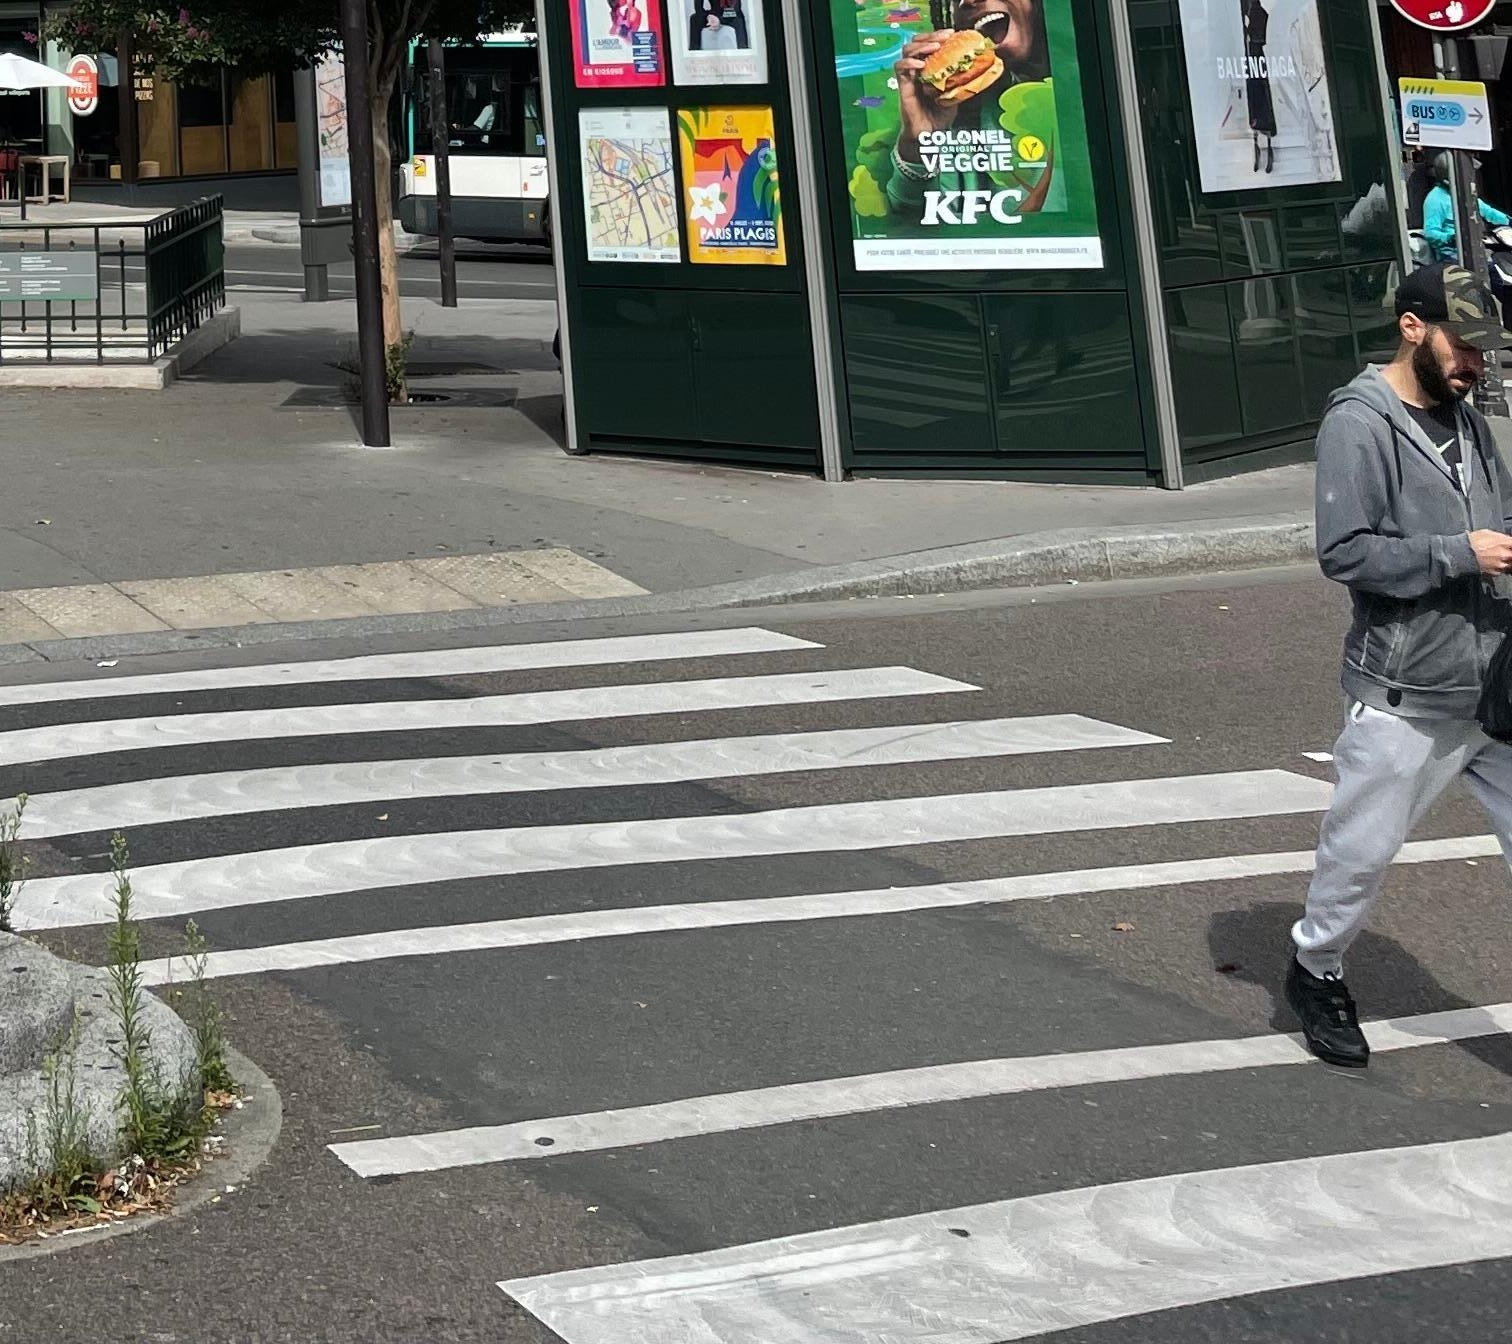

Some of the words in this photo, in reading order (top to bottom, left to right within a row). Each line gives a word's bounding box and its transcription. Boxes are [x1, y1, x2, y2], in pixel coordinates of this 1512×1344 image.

[1411, 103, 1435, 119] BUS
[918, 129, 1011, 146] COLONEL
[940, 145, 990, 154] ORIGINAL
[920, 152, 1014, 173] VEGGIE
[920, 189, 1023, 225] KFC
[699, 226, 732, 241] PARIS
